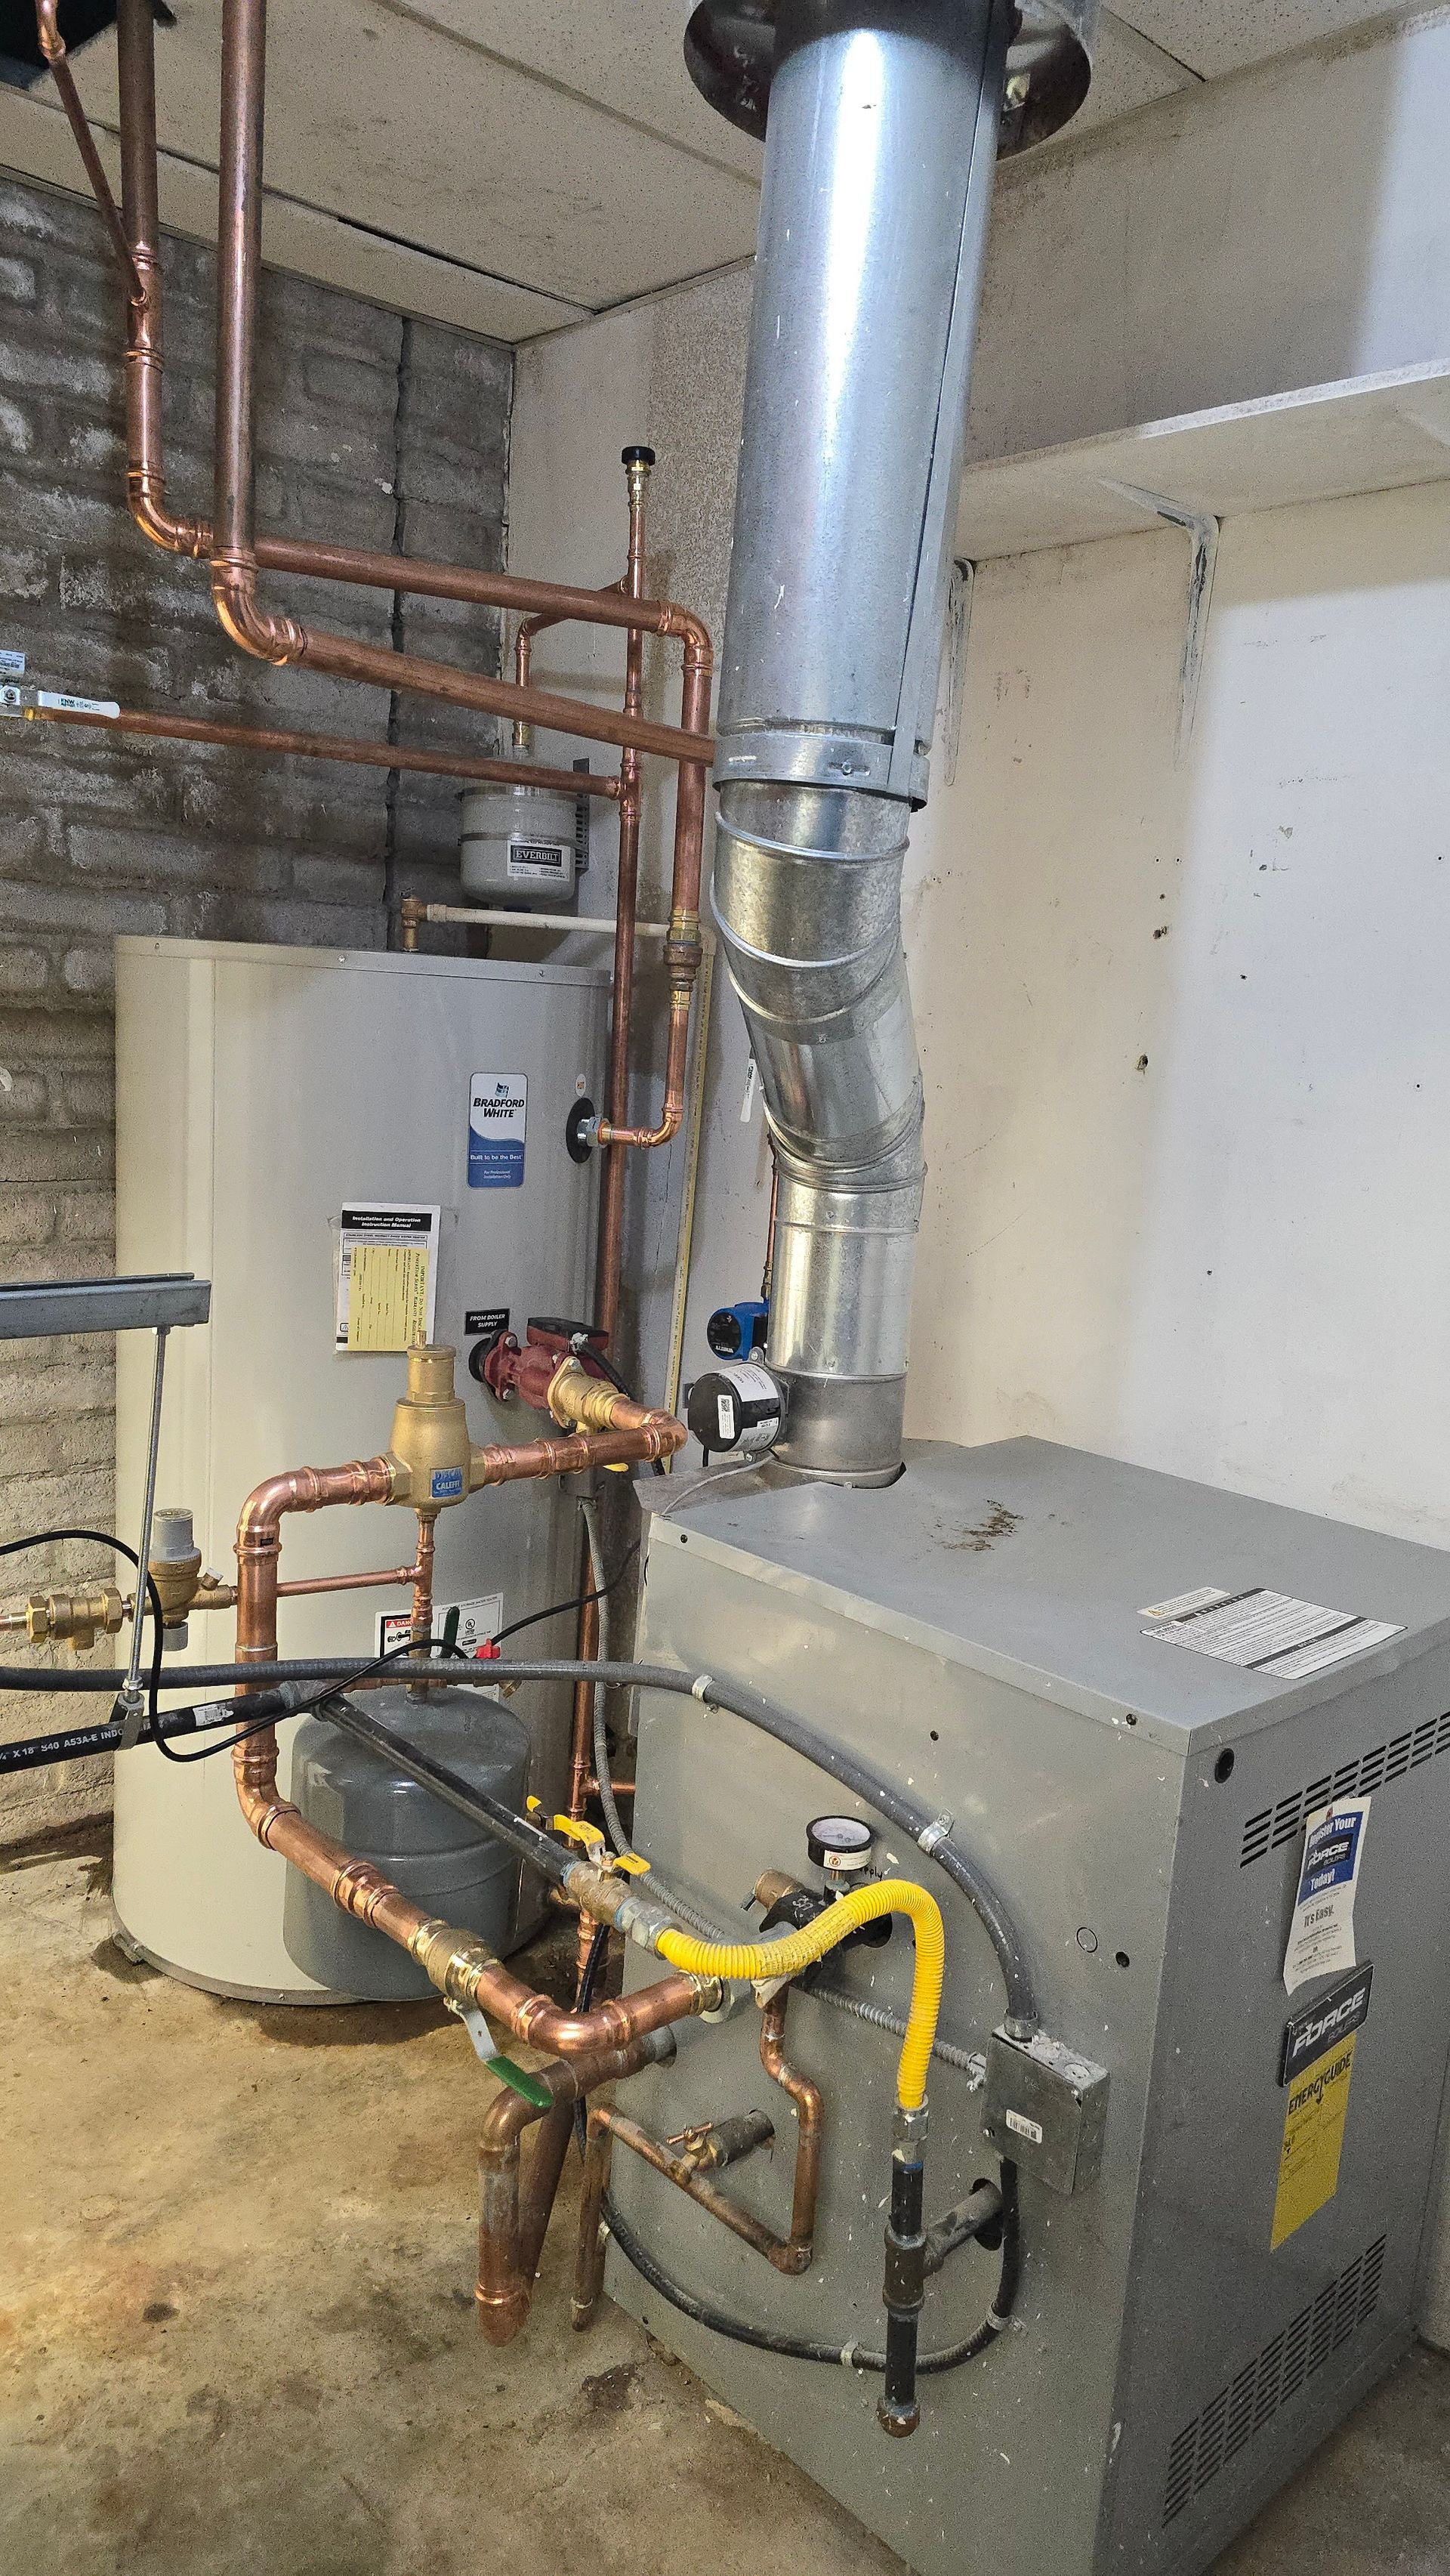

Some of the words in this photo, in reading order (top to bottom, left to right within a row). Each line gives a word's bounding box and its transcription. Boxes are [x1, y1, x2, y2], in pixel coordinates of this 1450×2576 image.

[515, 850, 559, 862] EVERBILT
[473, 1098, 525, 1107] BRADFORD
[483, 1107, 514, 1118] WHITE
[436, 1481, 460, 1490] CALEFFI
[12, 1750, 21, 1758] X
[63, 1734, 99, 1748] A53A-E
[1334, 1817, 1357, 1831] Your
[1307, 1841, 1350, 1871] FORCE
[1310, 1868, 1335, 1892] Today!
[1292, 1987, 1366, 2059] FORCE
